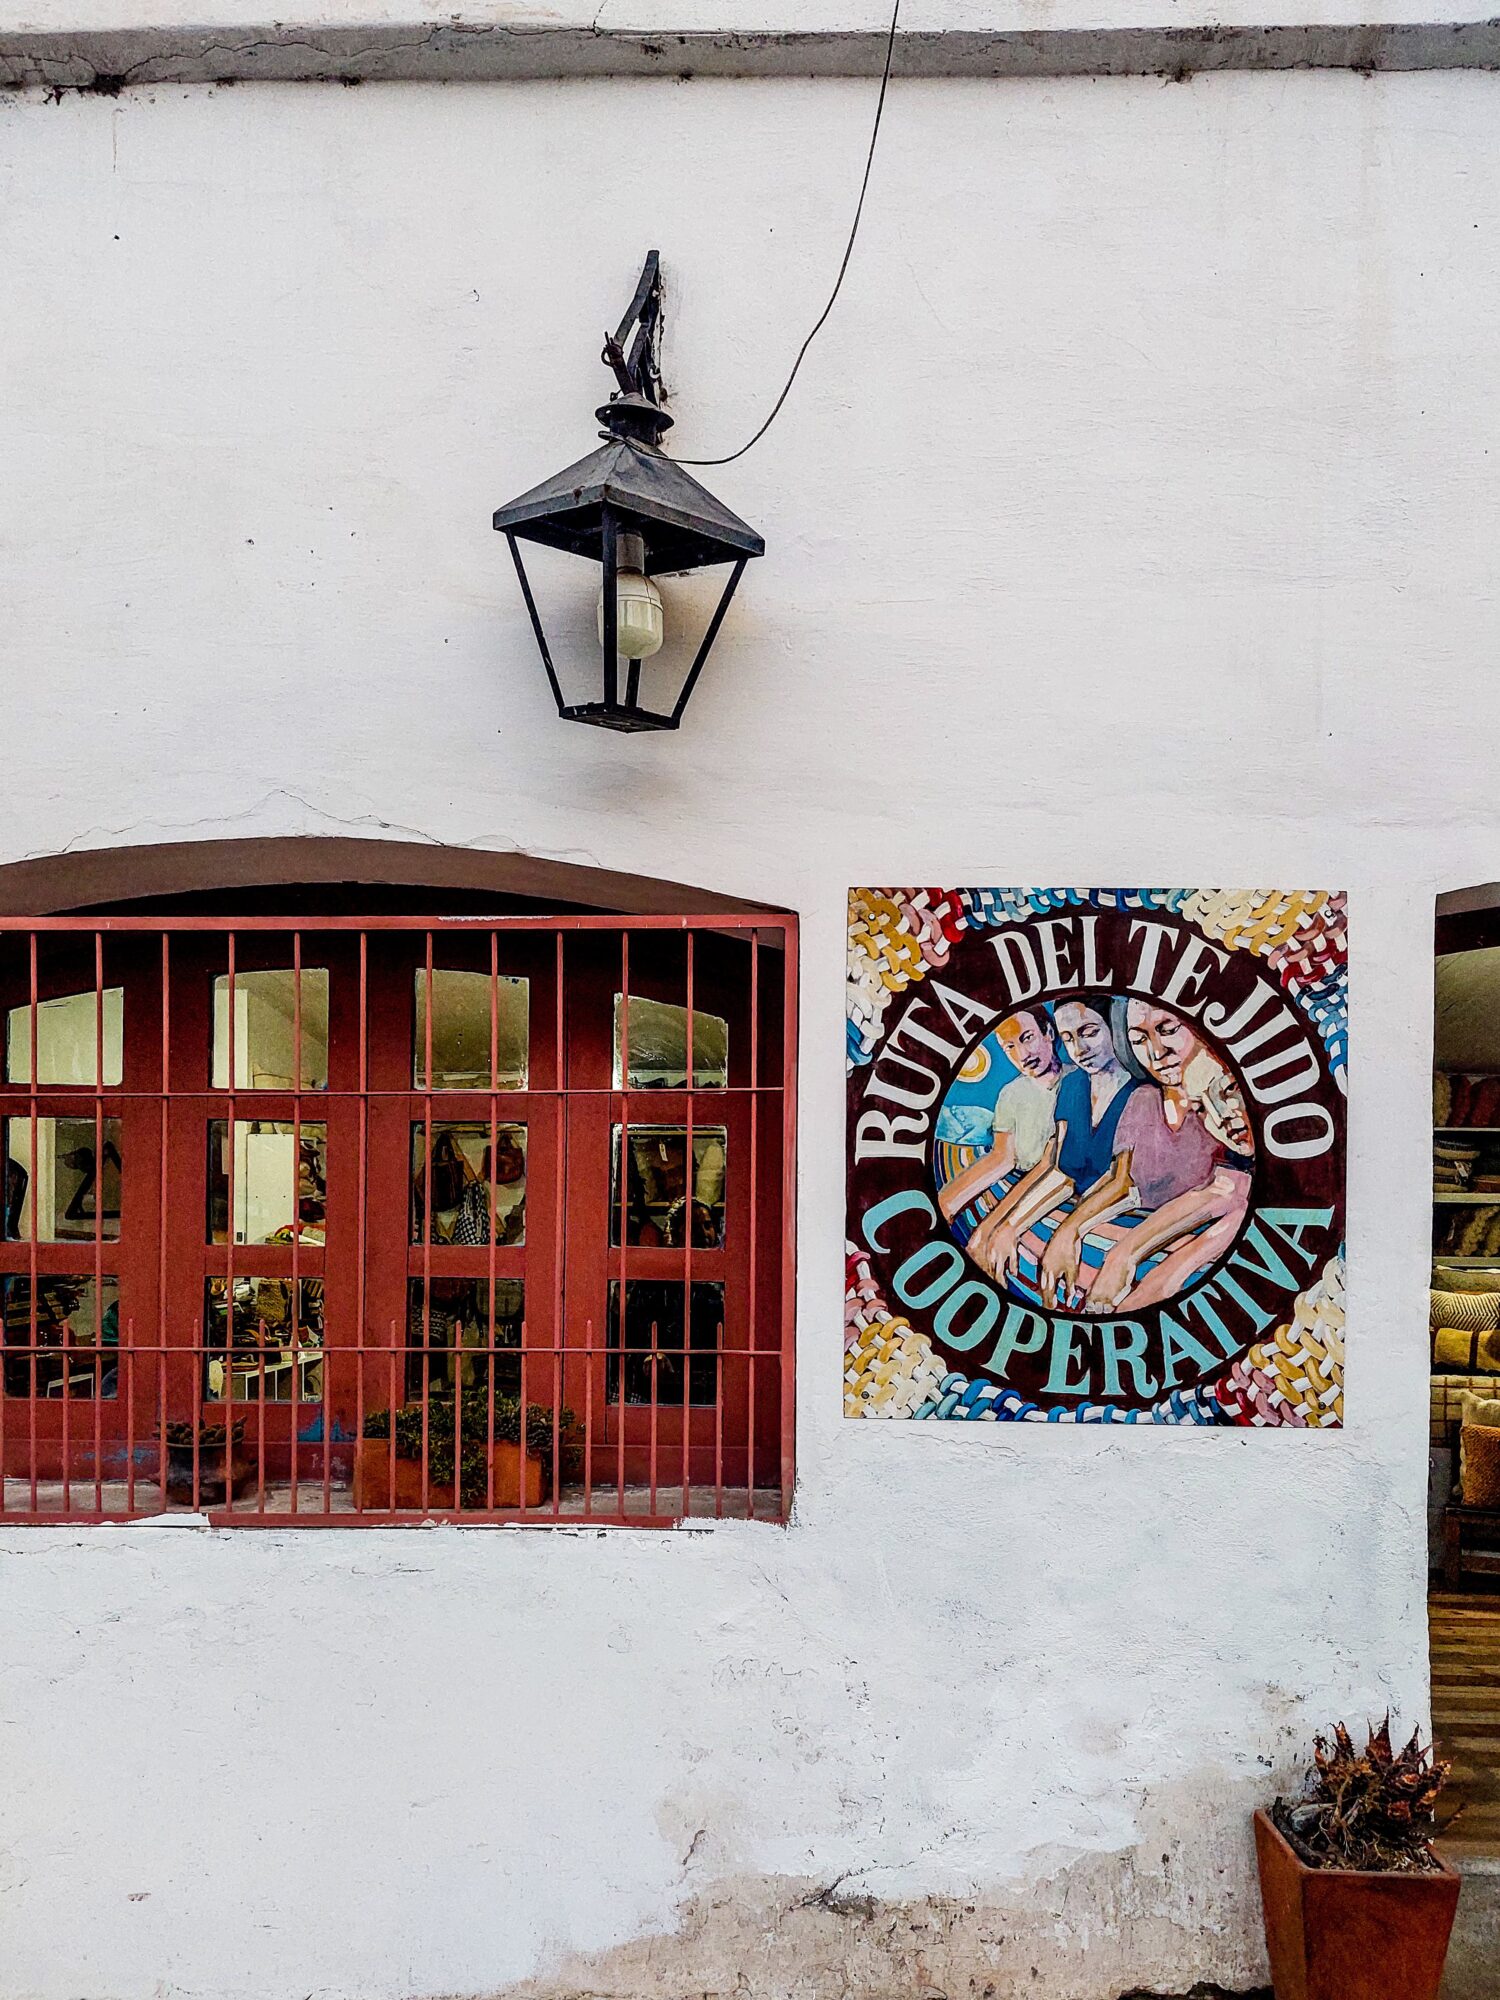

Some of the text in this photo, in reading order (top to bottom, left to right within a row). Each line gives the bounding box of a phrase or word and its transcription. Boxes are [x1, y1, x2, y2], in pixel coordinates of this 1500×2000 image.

[855, 915, 1335, 1166] RUTA DEL TEJIDO
[861, 1189, 1335, 1396] COOPERATIVA
